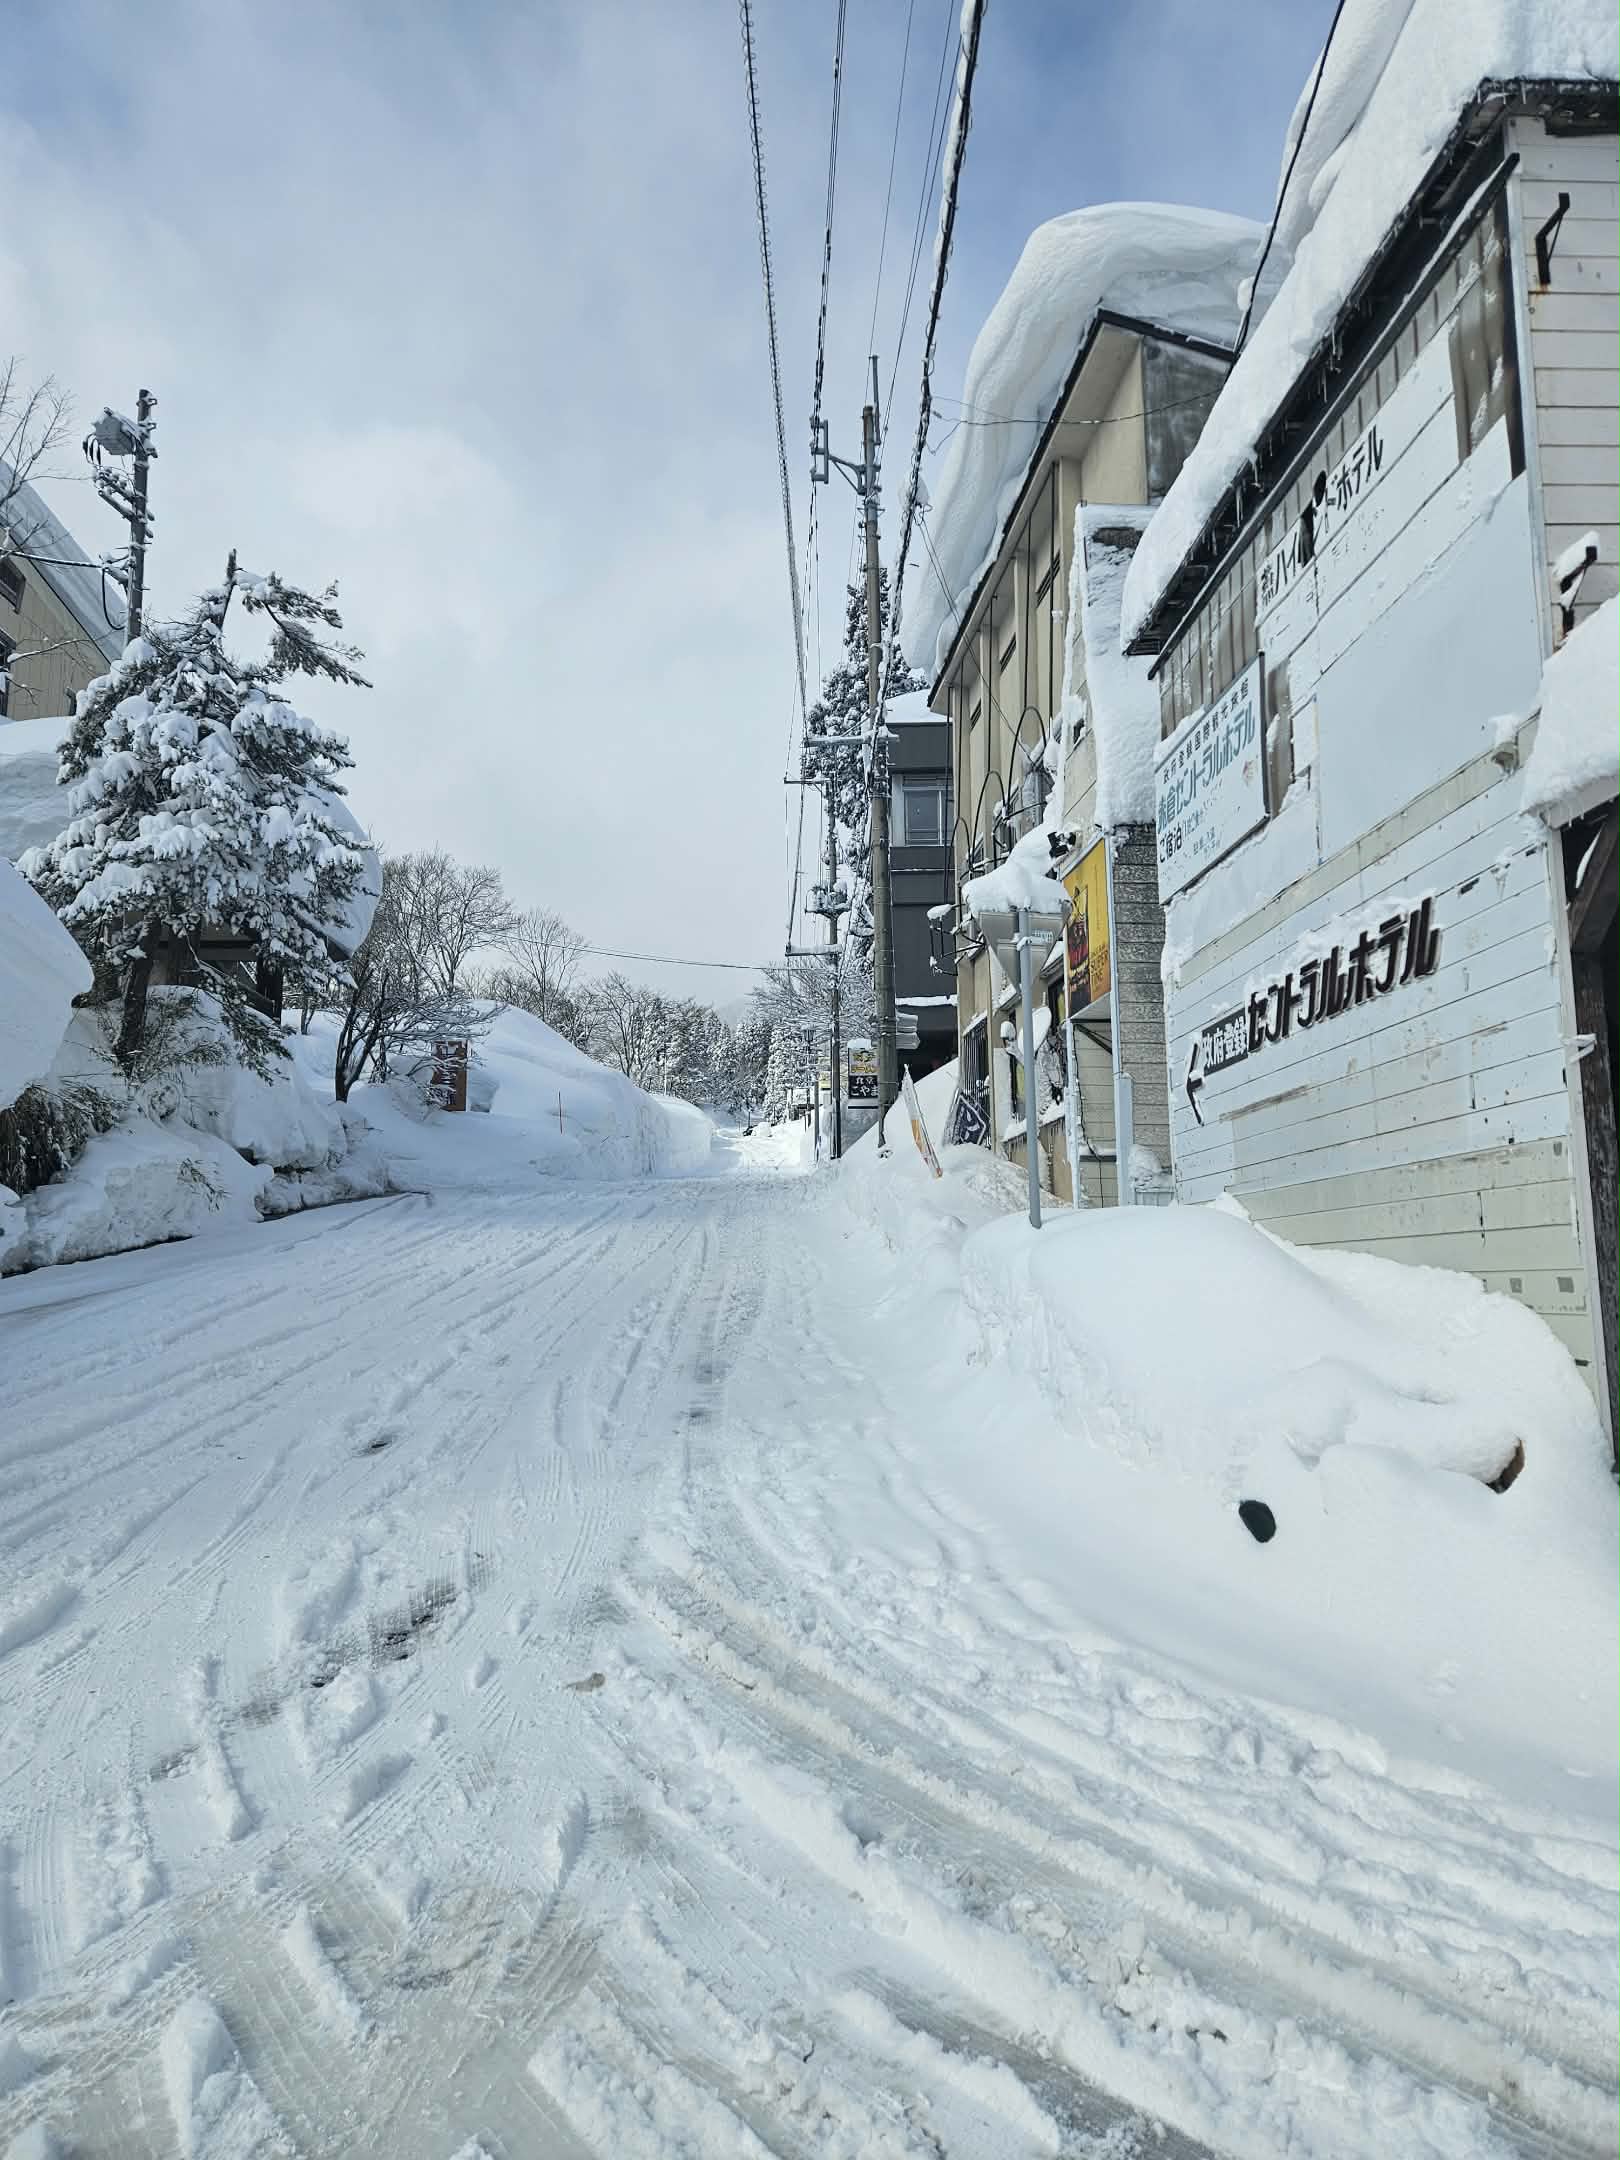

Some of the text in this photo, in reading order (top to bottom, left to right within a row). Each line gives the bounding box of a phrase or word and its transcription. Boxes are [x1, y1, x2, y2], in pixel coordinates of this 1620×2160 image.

[1261, 424, 1384, 607] 燕ハインドホテル
[1157, 700, 1256, 835] 赤倉セントラルホテル
[1159, 821, 1183, 864] ご宿泊
[1201, 895, 1441, 1068] 政府登録 セントラルホテル
